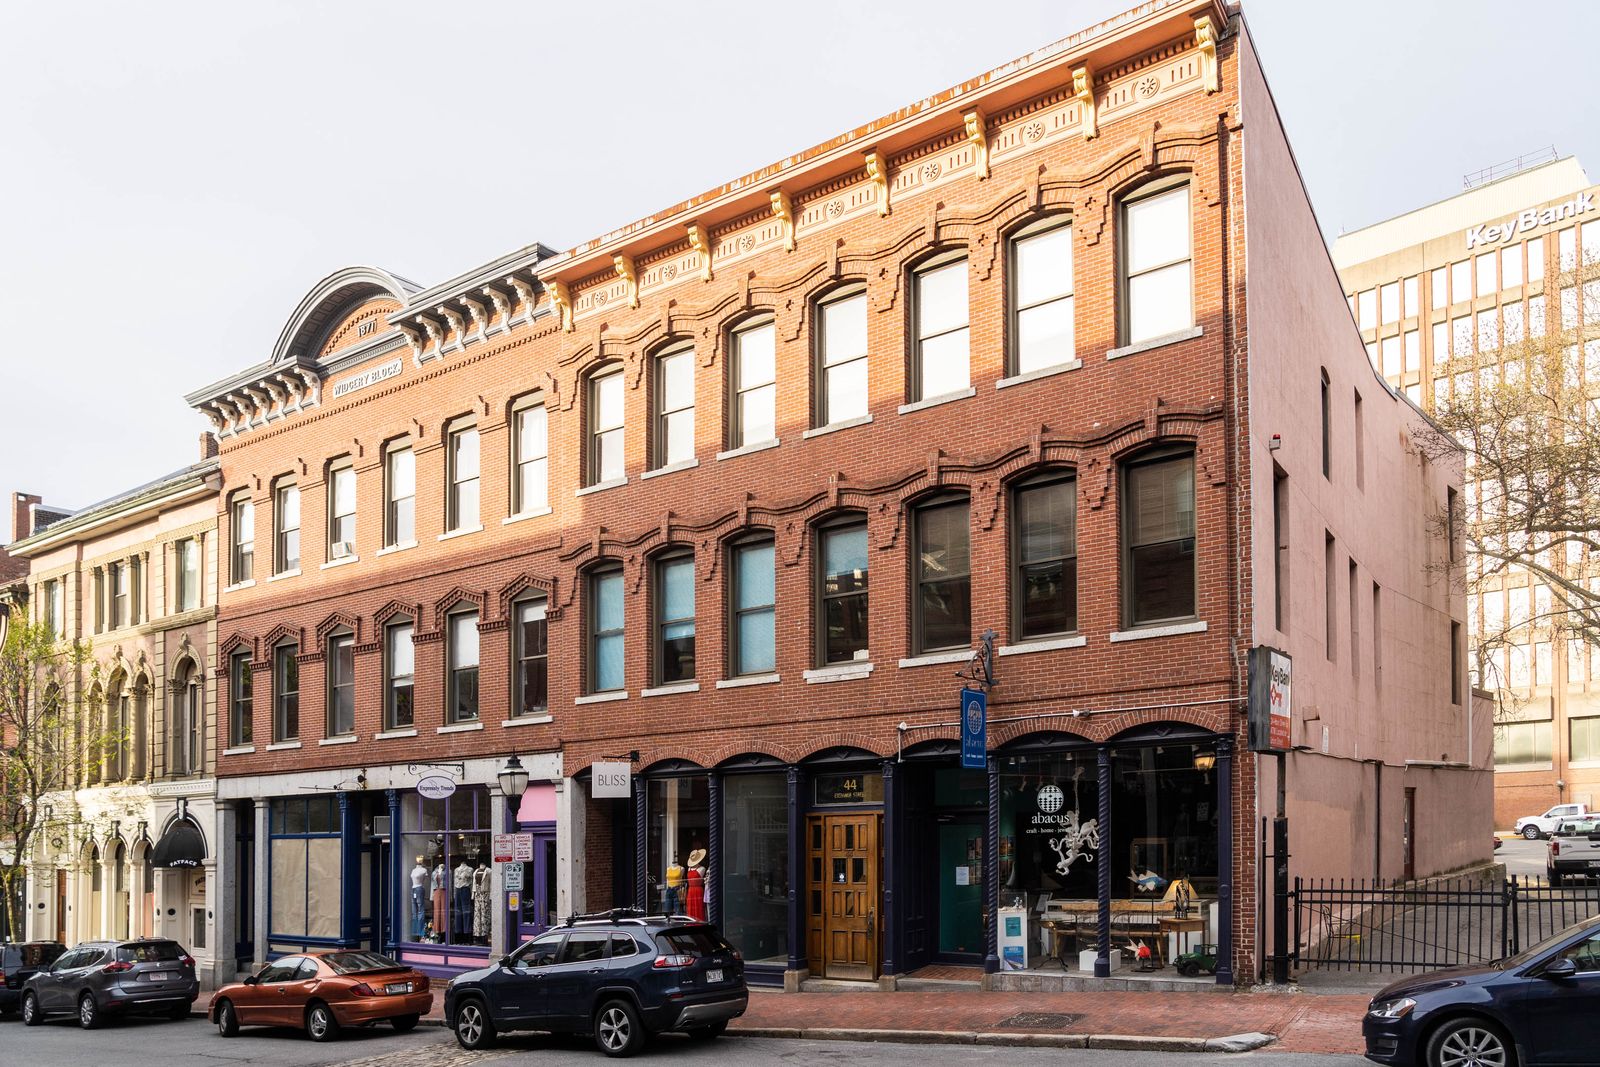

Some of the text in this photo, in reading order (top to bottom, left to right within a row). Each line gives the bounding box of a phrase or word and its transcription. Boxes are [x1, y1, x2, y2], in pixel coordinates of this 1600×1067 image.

[1465, 192, 1596, 250] KeyBank
[1271, 664, 1290, 687] KeyBan
[598, 774, 626, 786] BLISS
[843, 779, 857, 790] 44
[1031, 812, 1070, 824] abacus
